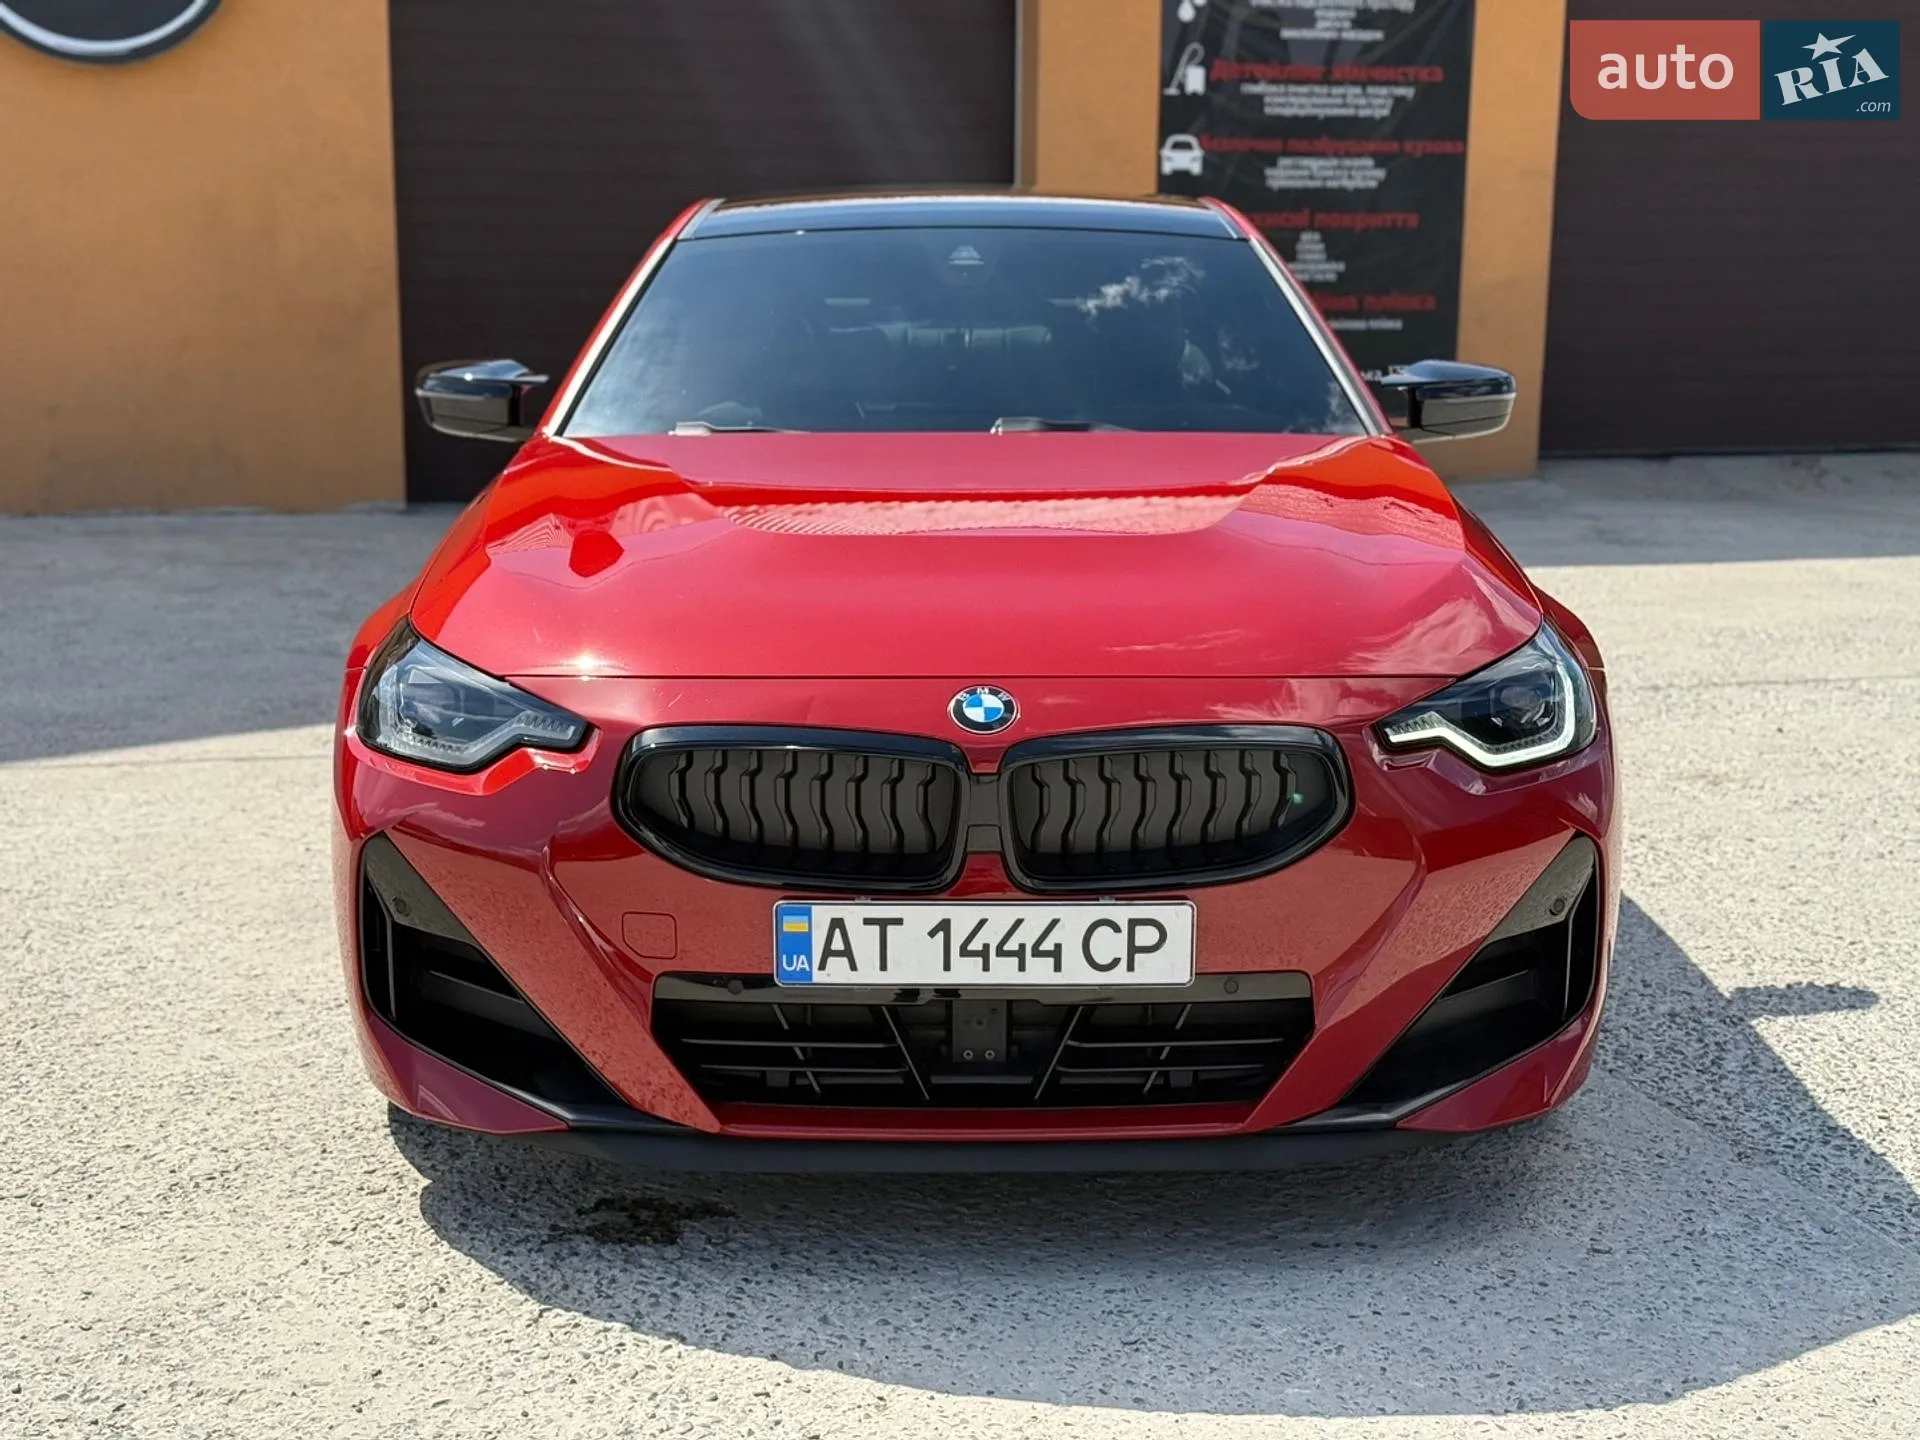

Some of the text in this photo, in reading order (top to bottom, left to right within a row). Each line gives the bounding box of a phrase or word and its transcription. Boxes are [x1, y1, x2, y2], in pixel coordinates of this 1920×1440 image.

[959, 686, 1011, 702] BMW
[817, 917, 1168, 972] AT 1444 CP
[782, 954, 810, 972] UA
